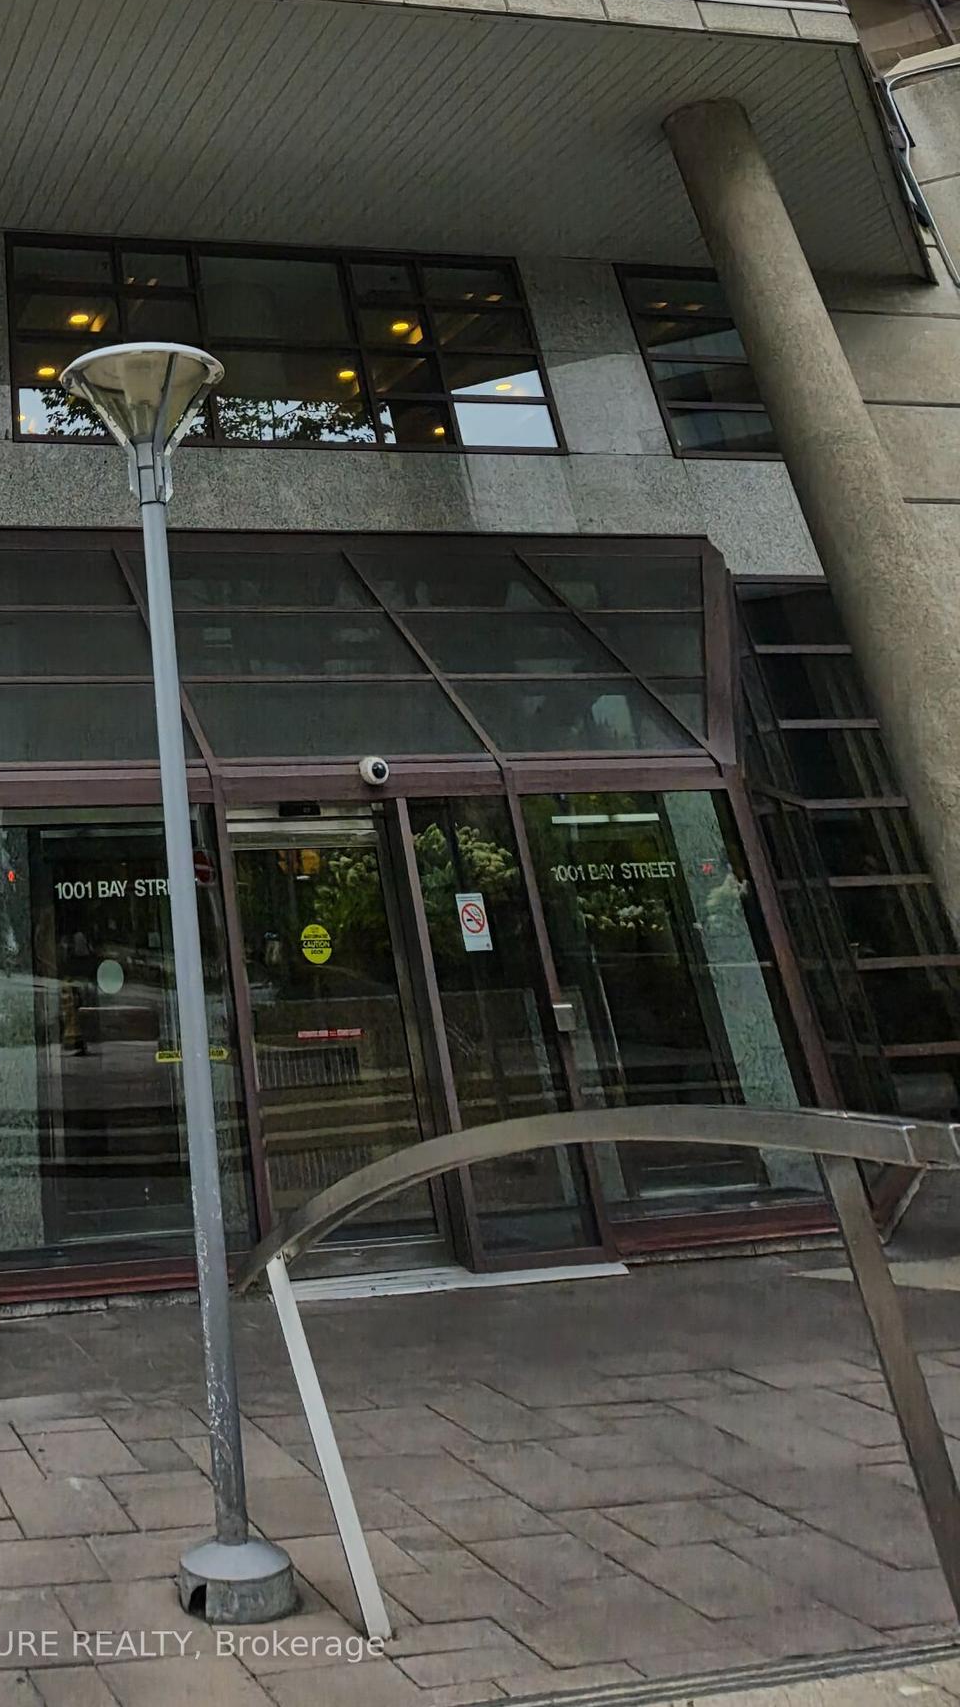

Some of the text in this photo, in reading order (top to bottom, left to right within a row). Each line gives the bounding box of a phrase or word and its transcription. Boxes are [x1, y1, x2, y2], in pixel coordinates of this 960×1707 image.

[550, 861, 676, 882] 1001 BAY STREET
[54, 881, 93, 899] 1001
[97, 880, 128, 898] BAY
[302, 940, 330, 948] CAUTION
